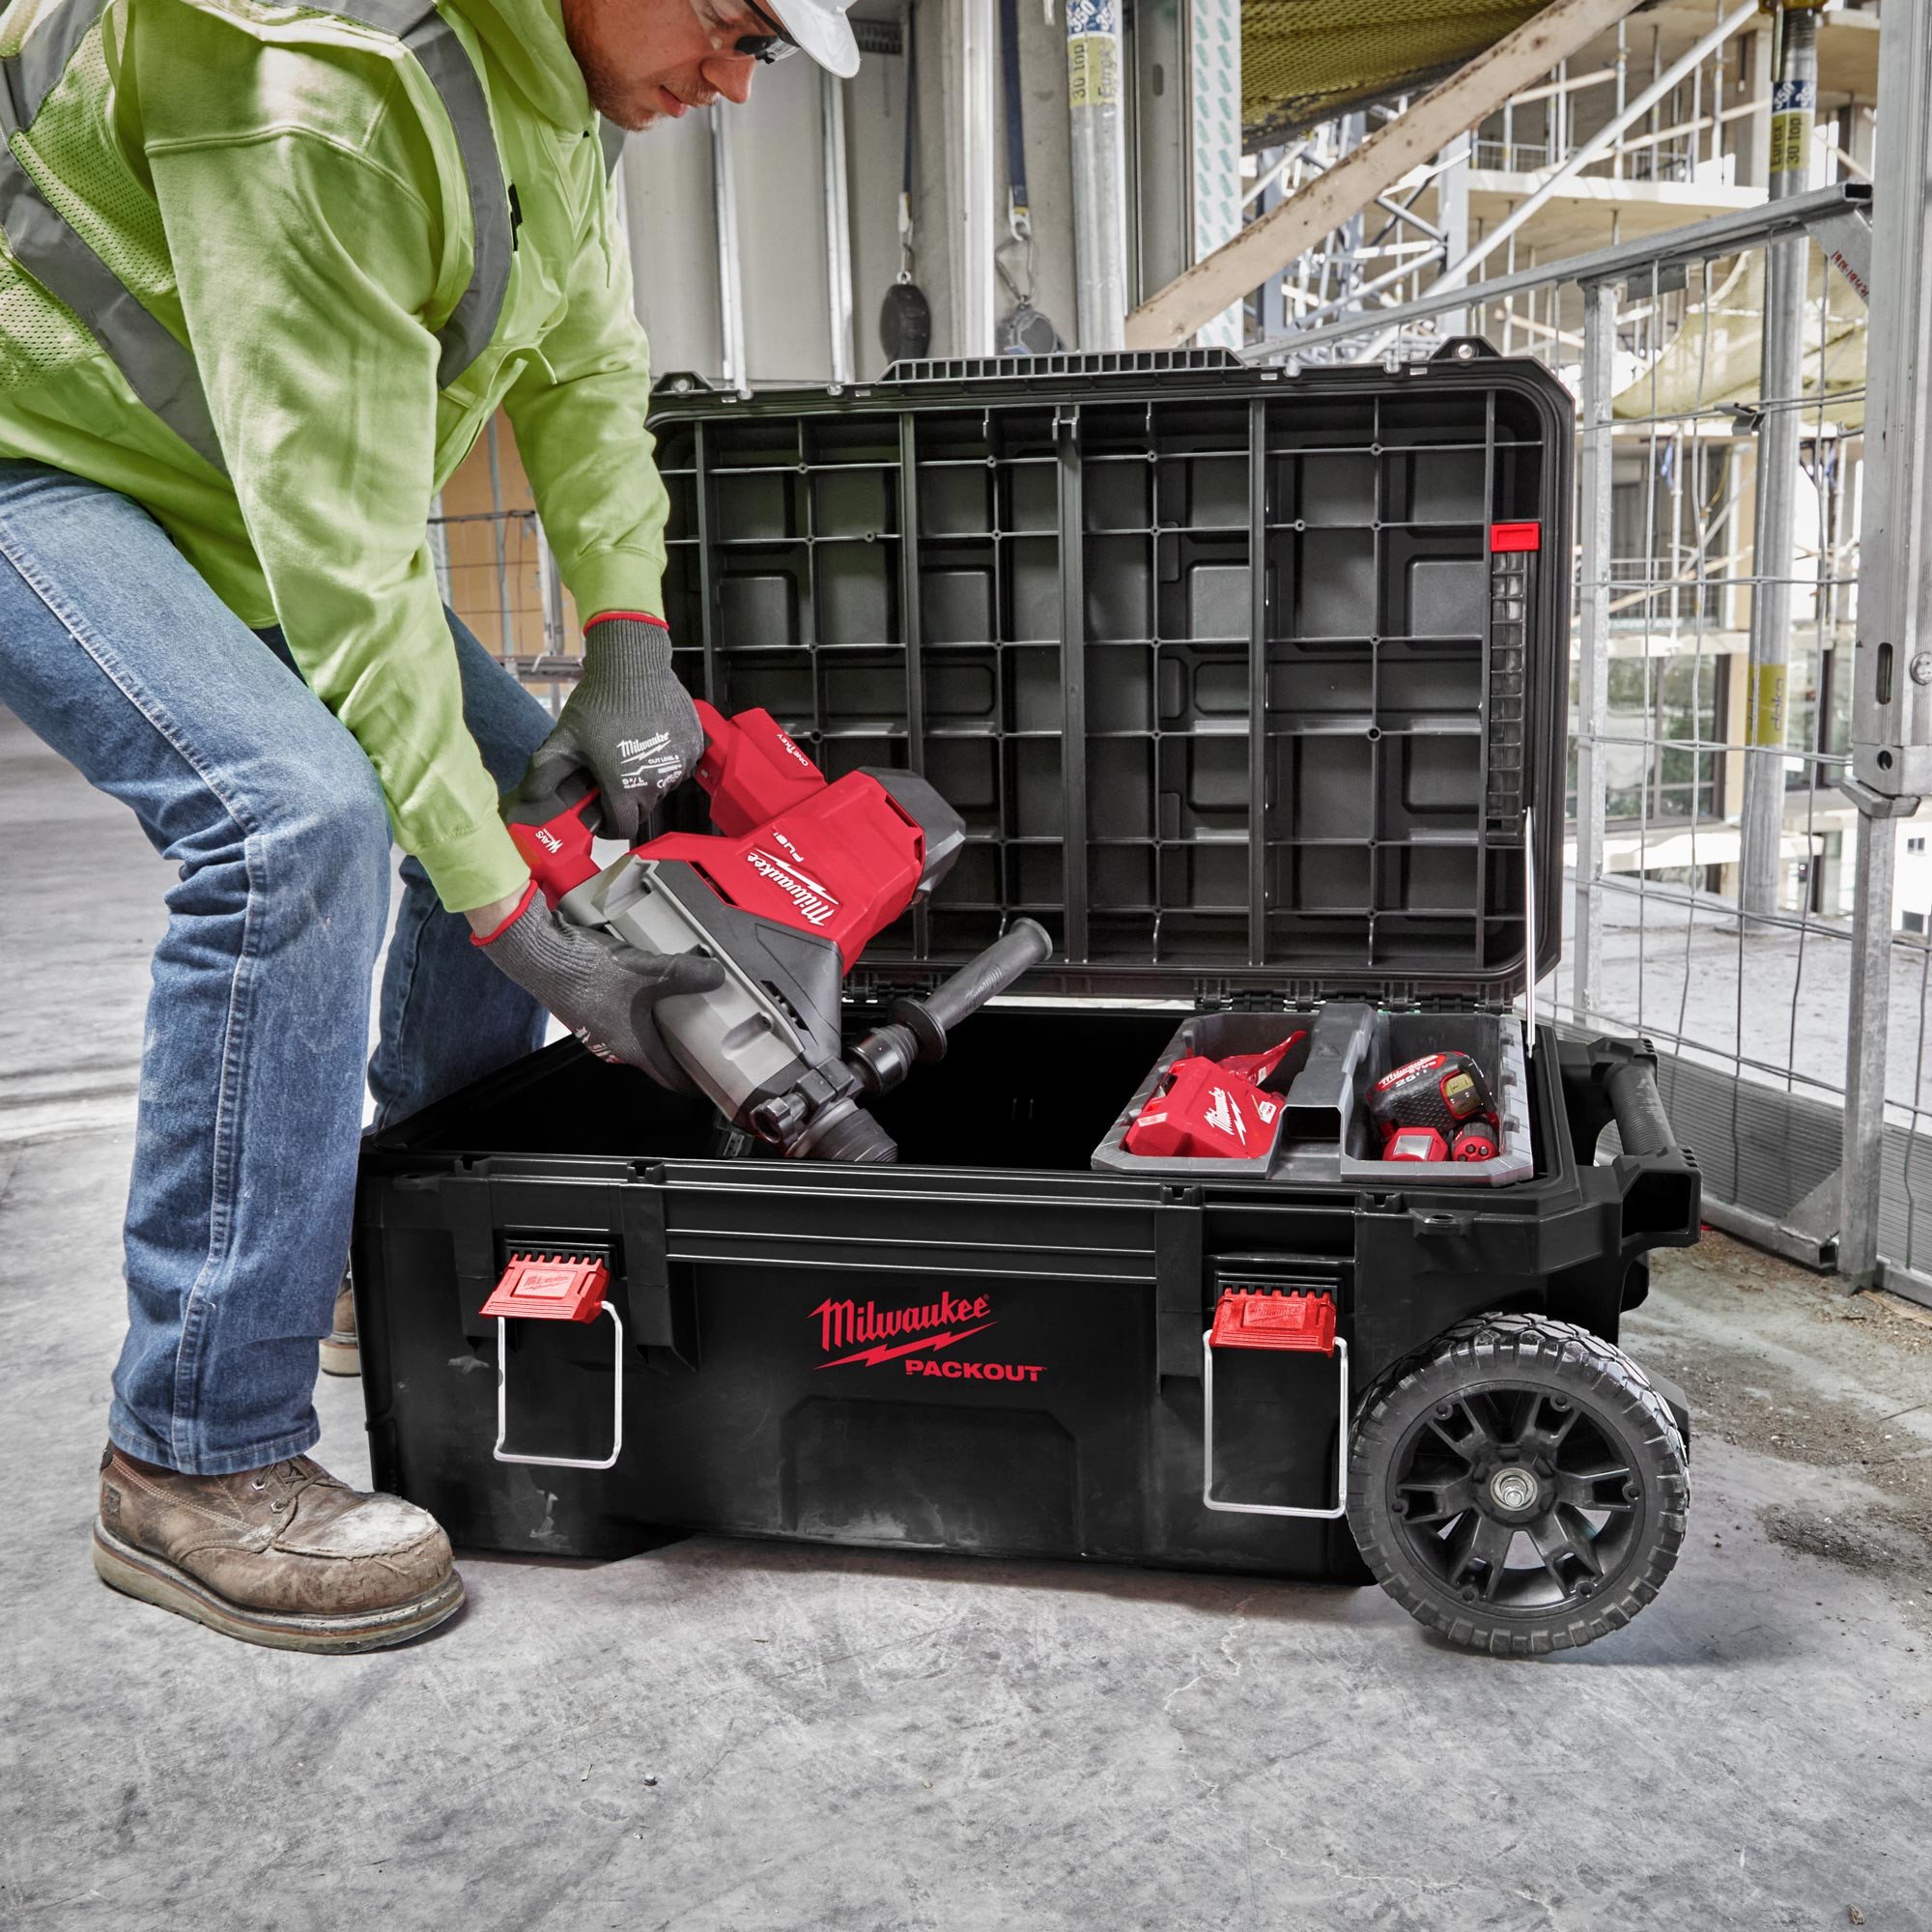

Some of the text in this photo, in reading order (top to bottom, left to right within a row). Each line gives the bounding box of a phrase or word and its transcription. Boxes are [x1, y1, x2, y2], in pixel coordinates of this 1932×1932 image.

[747, 851, 836, 927] Milwaukee
[805, 1291, 991, 1352] Milwaukee
[904, 1359, 1043, 1382] PACKOUT
